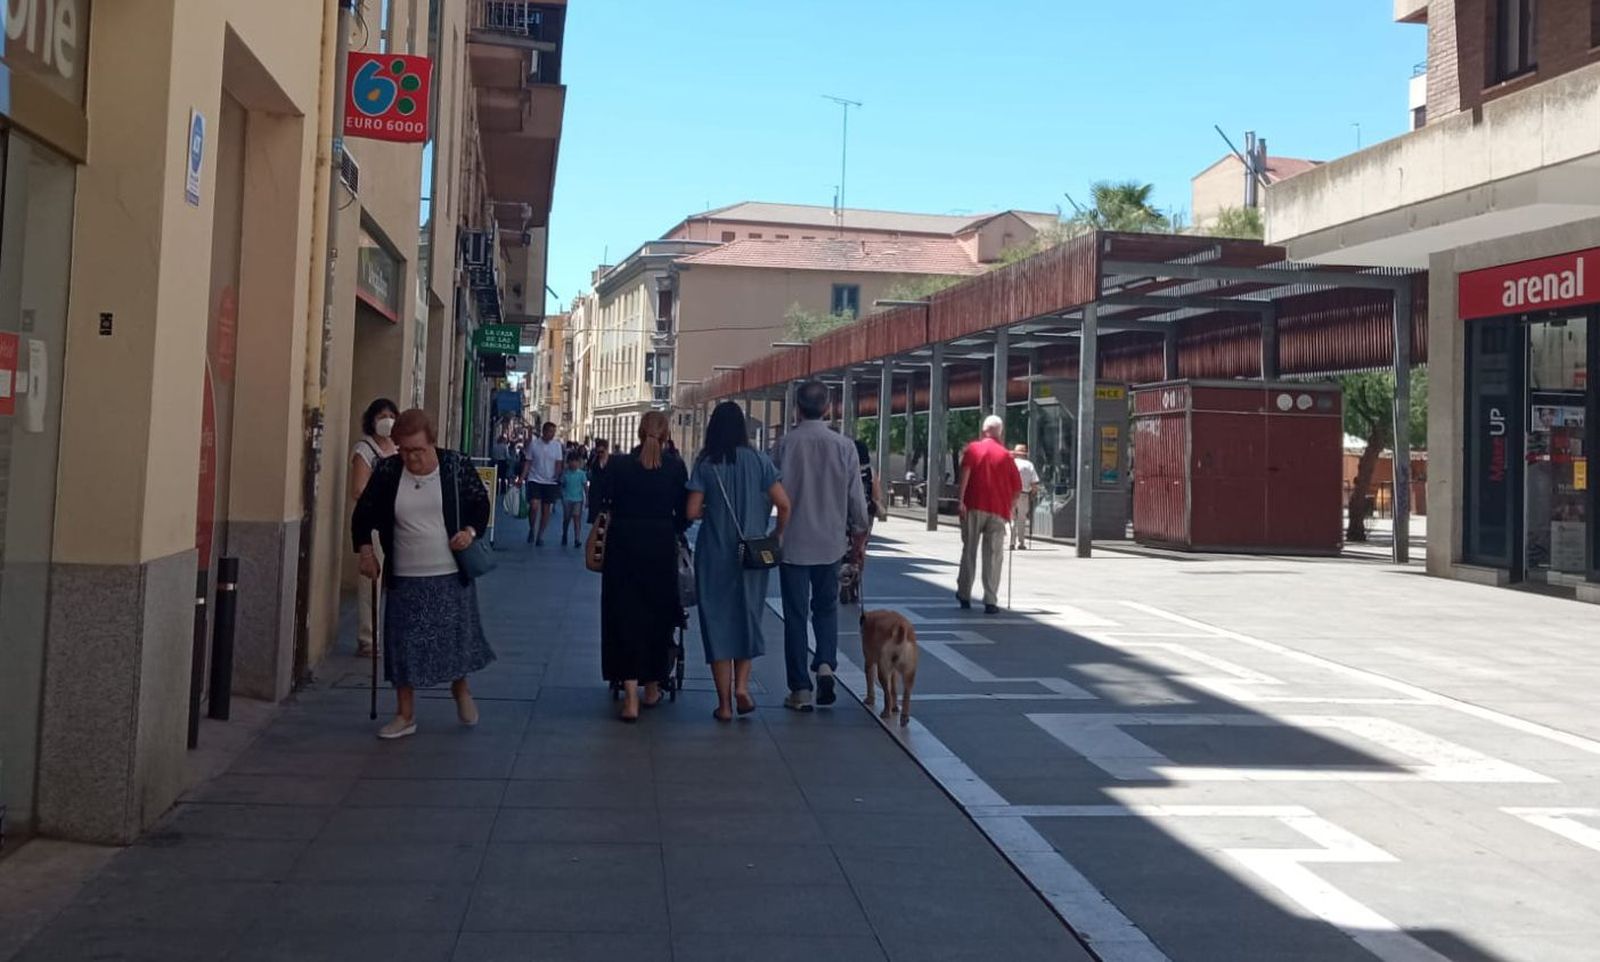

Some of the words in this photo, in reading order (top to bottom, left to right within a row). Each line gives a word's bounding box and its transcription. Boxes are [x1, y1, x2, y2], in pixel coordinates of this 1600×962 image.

[346, 116, 383, 130] EURO
[386, 120, 424, 134] 6000
[1502, 256, 1584, 307] arenal
[1095, 388, 1119, 398] NCE
[1489, 407, 1506, 436] UP
